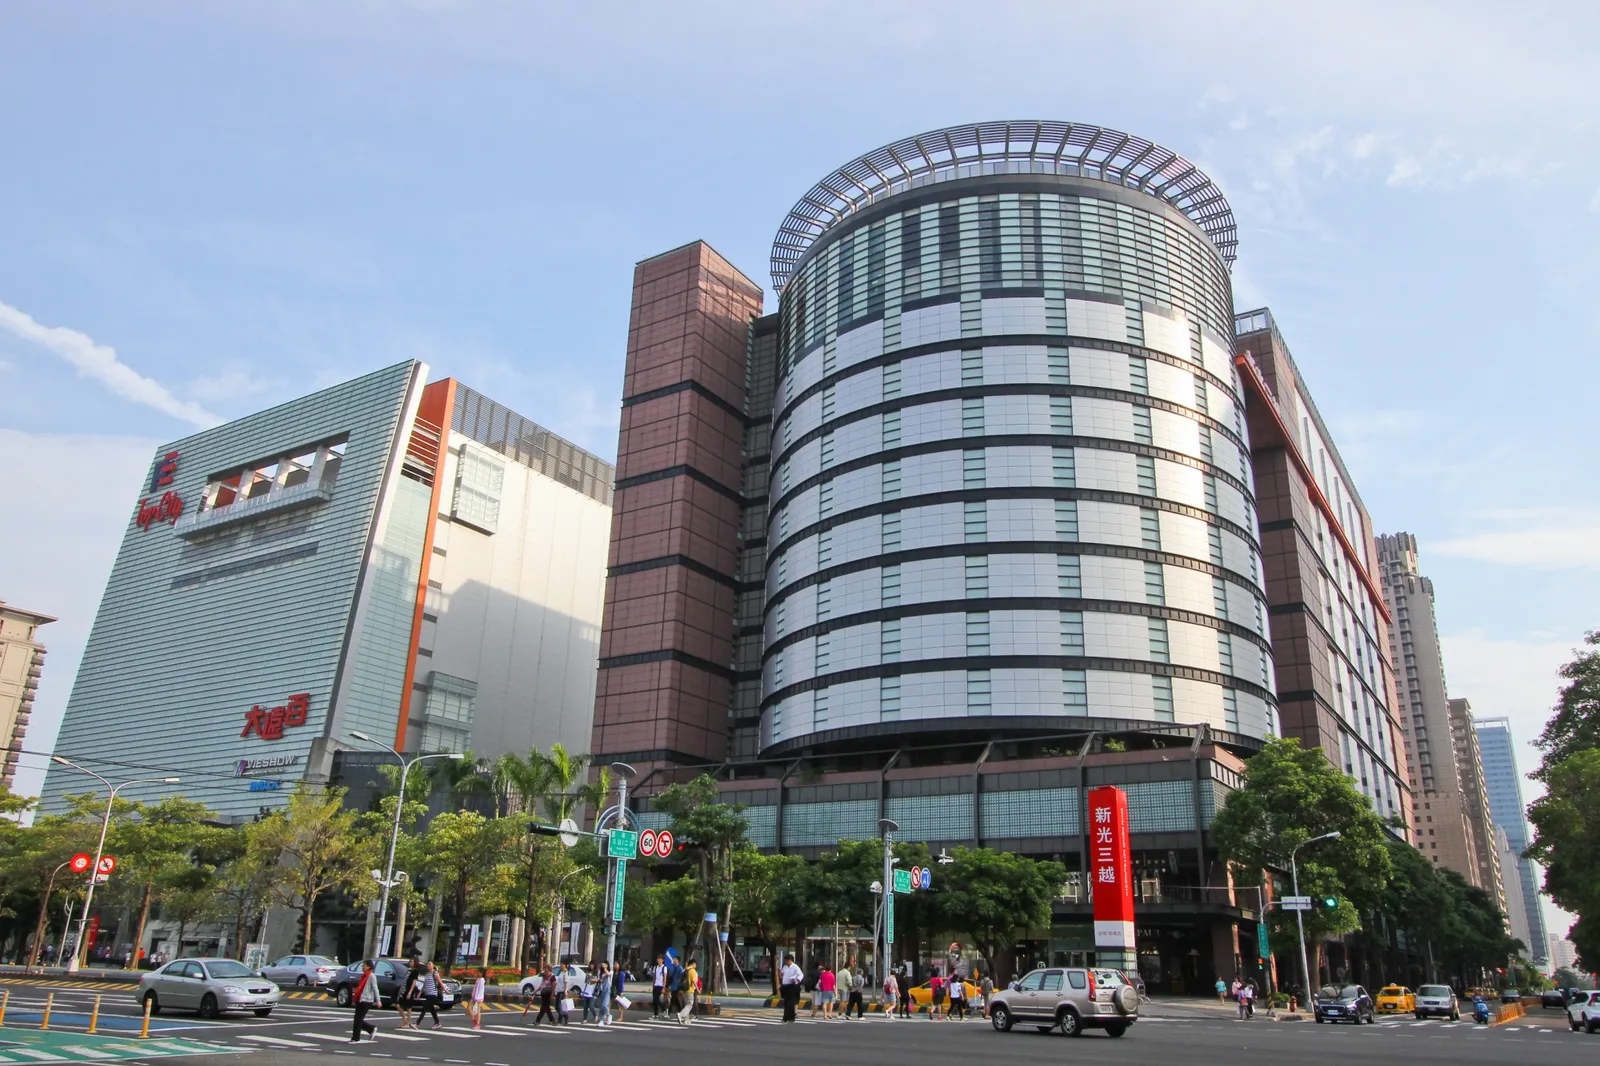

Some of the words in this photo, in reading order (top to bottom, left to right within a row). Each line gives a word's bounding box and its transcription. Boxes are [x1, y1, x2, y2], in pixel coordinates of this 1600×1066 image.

[240, 692, 310, 740] 大遠百
[644, 838, 653, 847] 60
[1095, 806, 1115, 883] 新光三越
